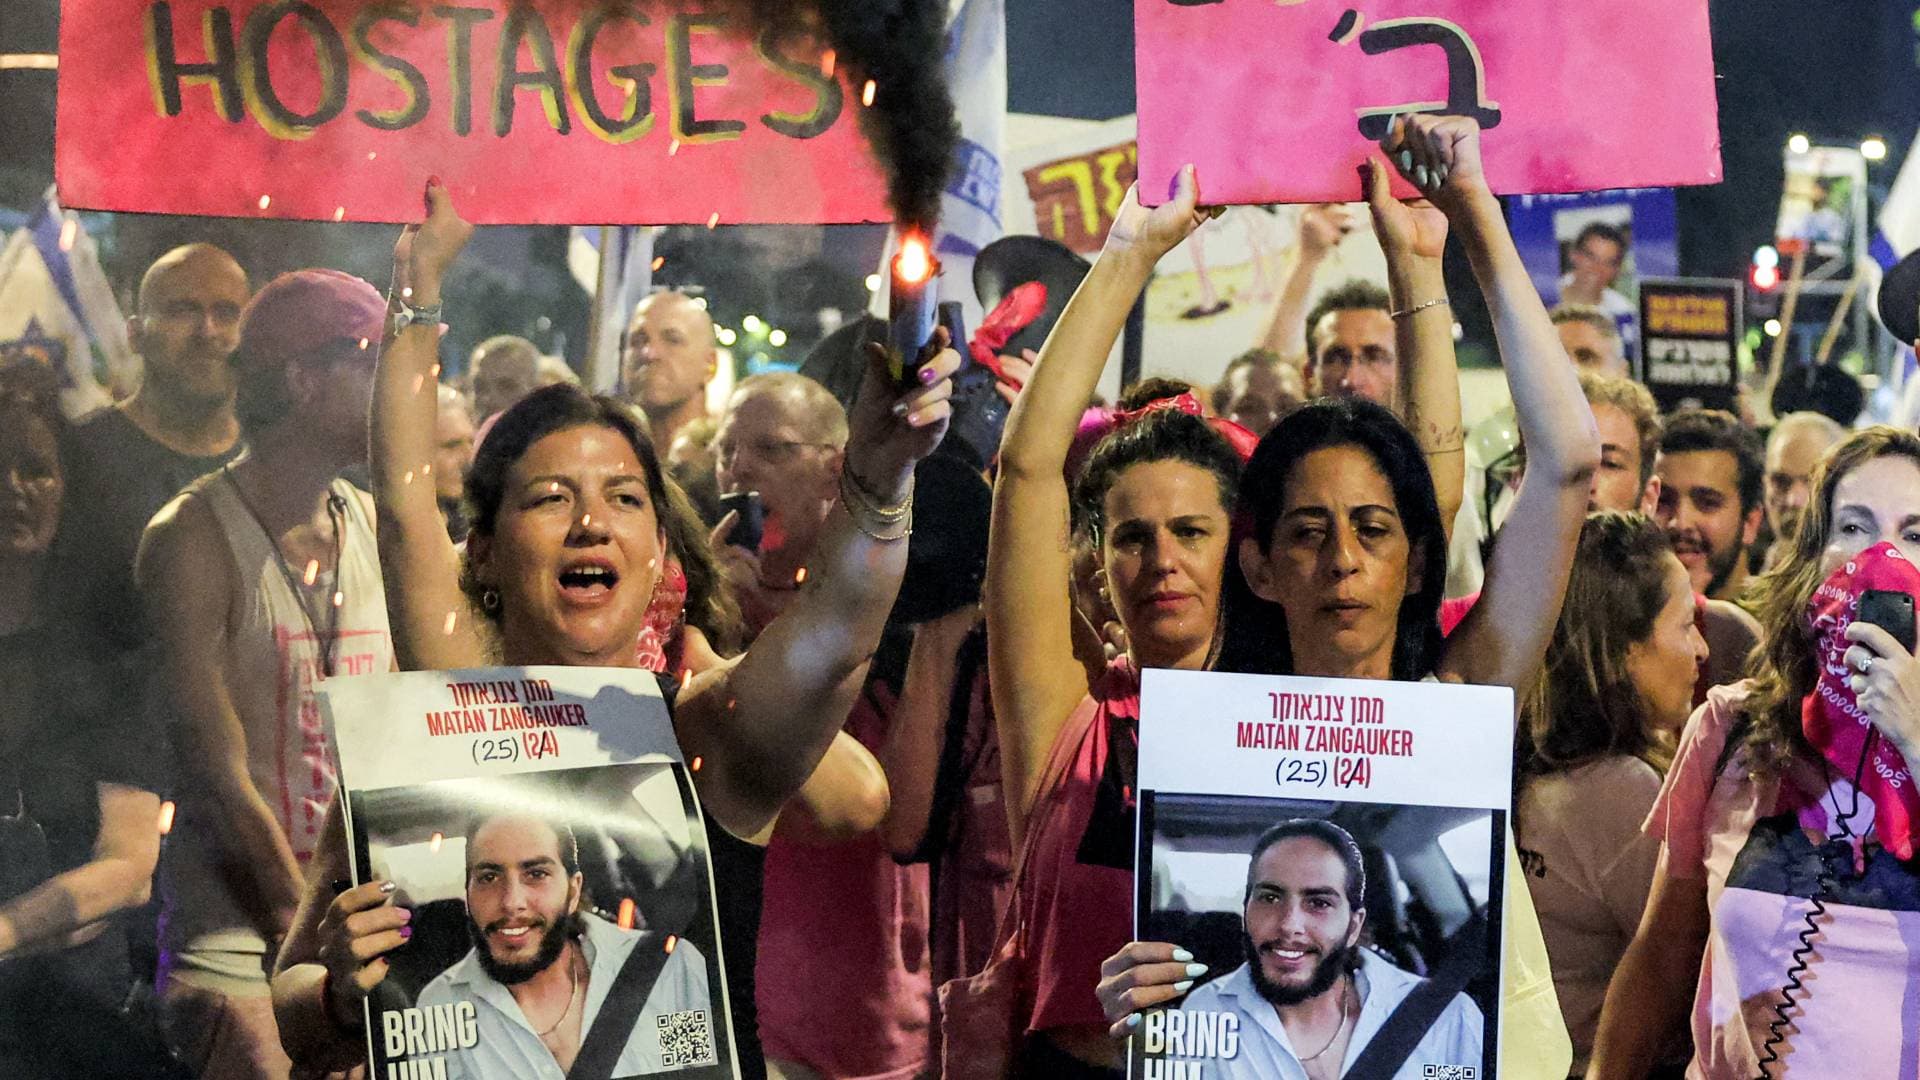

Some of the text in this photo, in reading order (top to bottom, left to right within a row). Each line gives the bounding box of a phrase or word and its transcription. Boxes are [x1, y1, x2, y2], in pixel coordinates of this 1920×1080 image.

[144, 0, 844, 144] HOSTAGES
[446, 679, 554, 708] מתן צנגאוקר
[1268, 692, 1385, 726] מתן צנגאוקר
[426, 704, 589, 737] MATAN ZANGAUKER
[472, 736, 519, 765] (25)
[1237, 721, 1413, 757] MATAN ZANGAUKER
[1275, 757, 1328, 788] (25)
[383, 1000, 478, 1058] BRING
[1144, 1008, 1240, 1059] BRING
